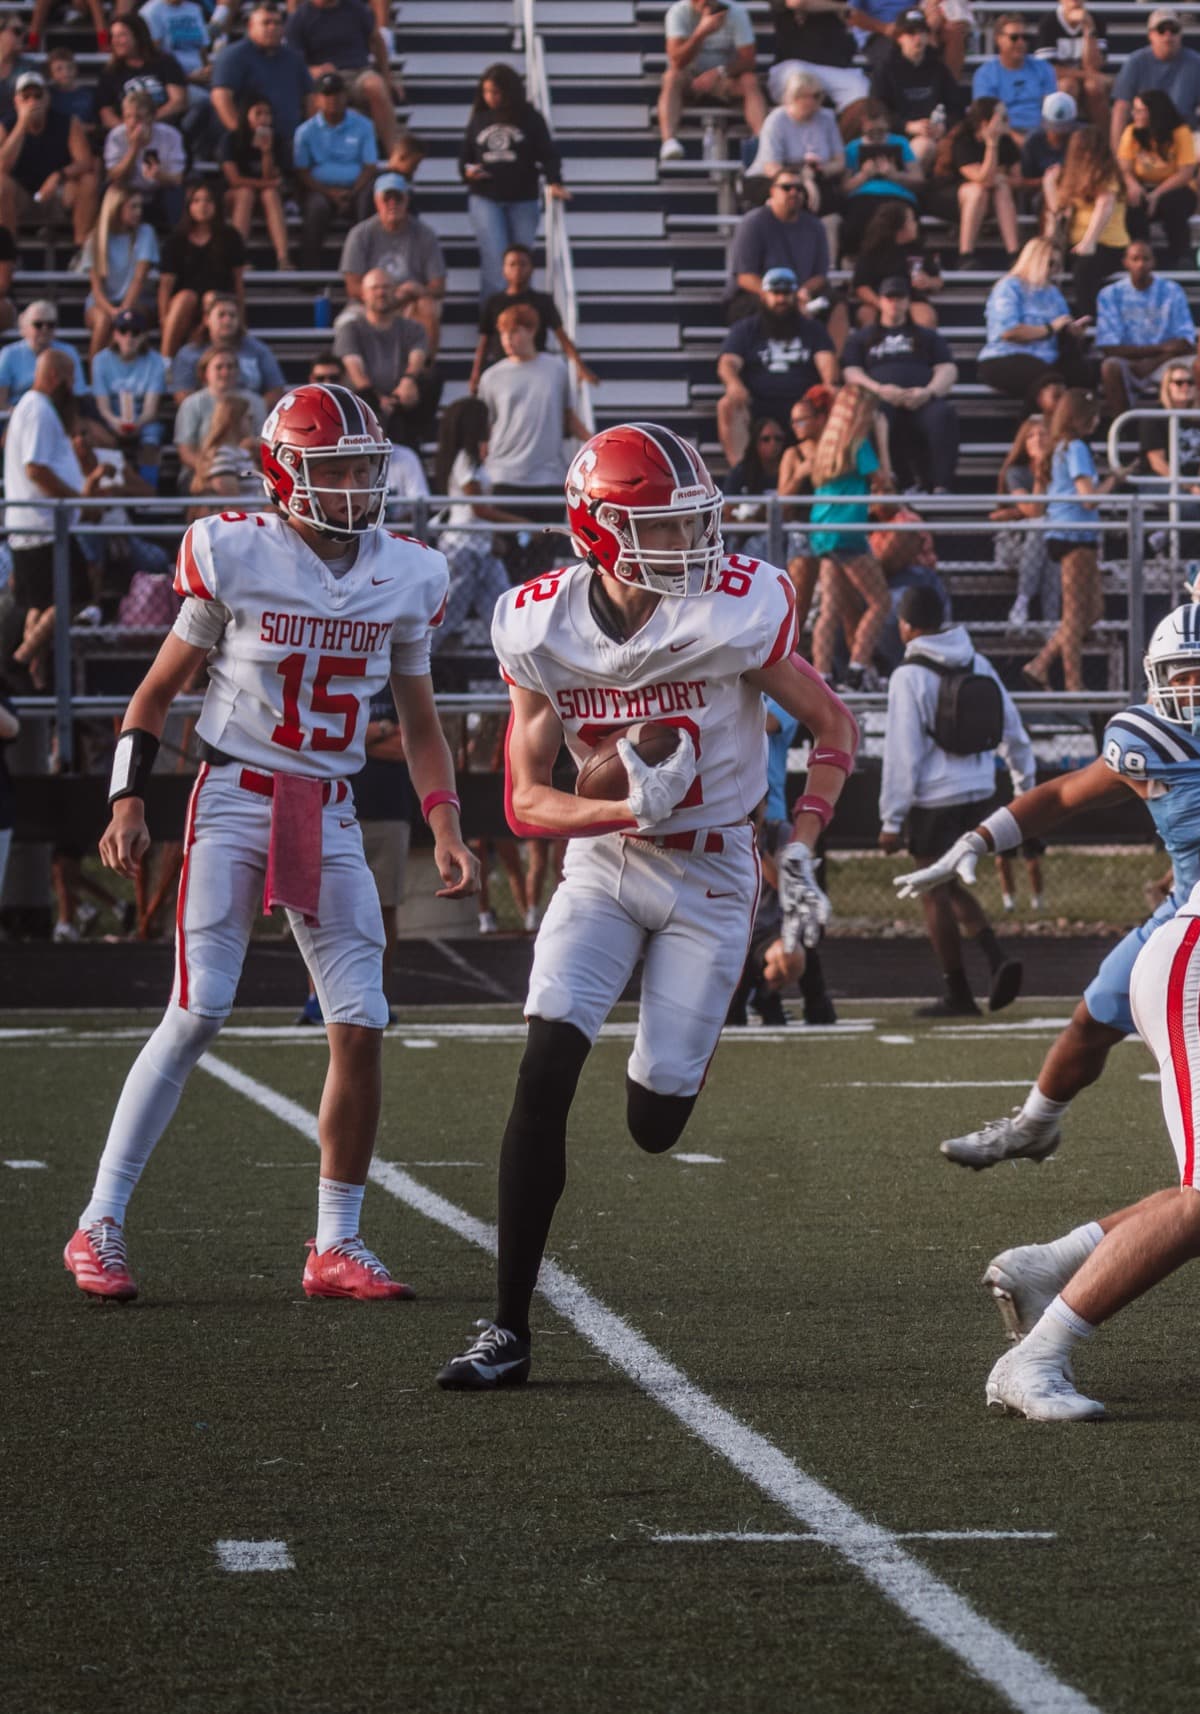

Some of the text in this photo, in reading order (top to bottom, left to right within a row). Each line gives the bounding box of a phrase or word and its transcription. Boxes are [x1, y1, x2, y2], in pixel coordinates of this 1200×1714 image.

[343, 435, 372, 446] Riddell
[260, 611, 394, 653] SOUTHPORT
[271, 652, 368, 753] 15
[556, 679, 707, 721] SOUTHPORT
